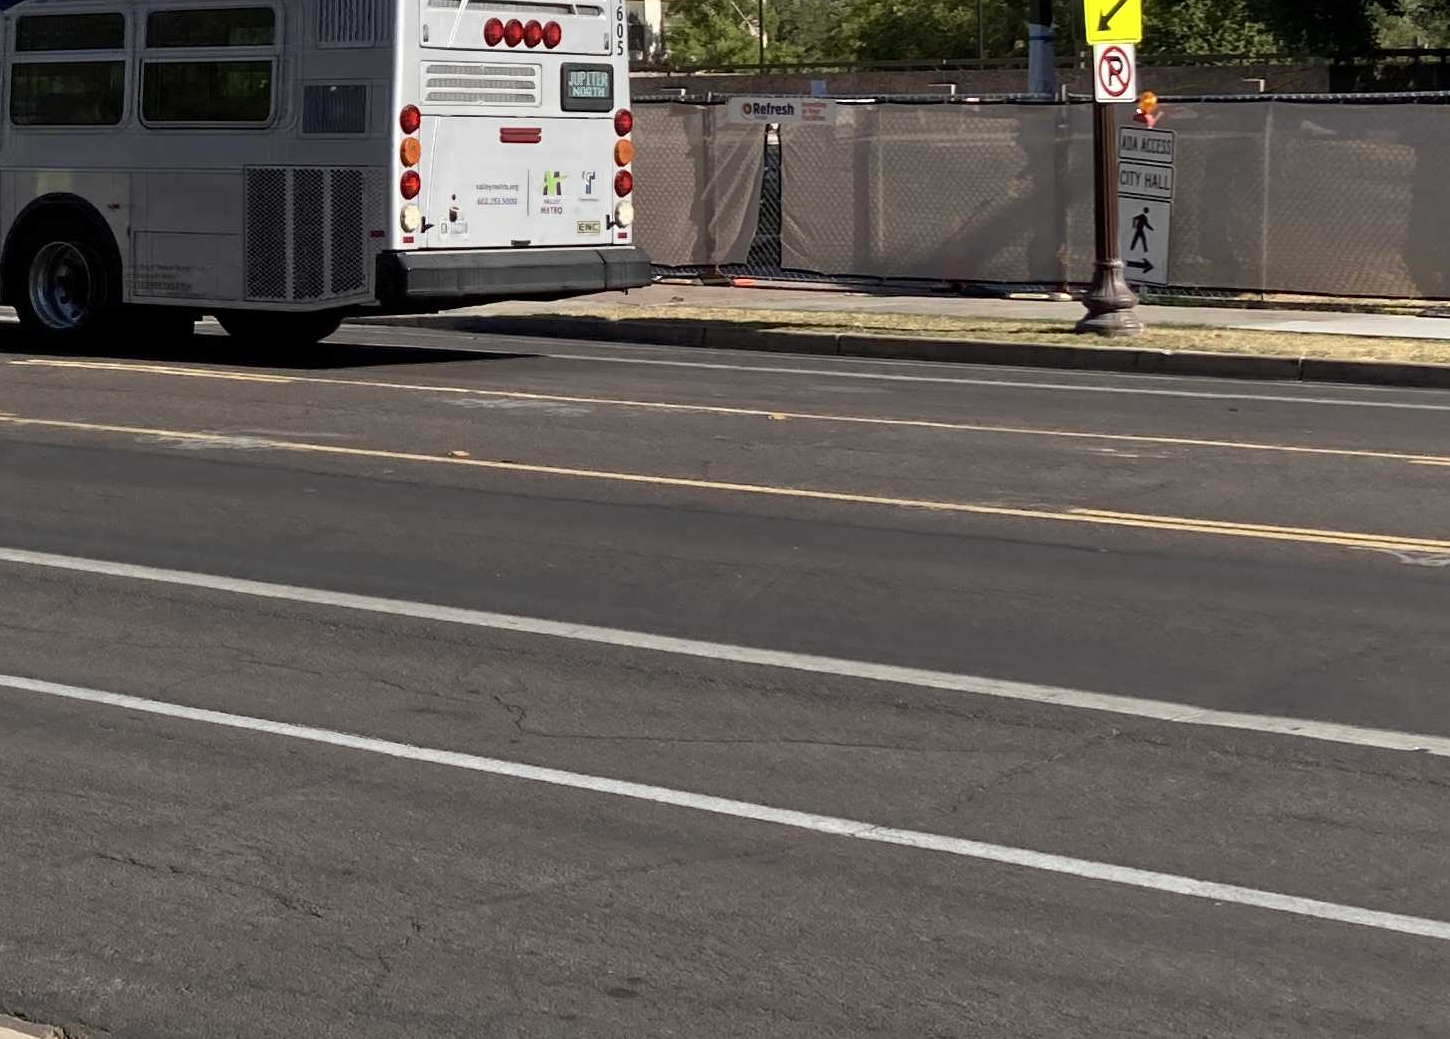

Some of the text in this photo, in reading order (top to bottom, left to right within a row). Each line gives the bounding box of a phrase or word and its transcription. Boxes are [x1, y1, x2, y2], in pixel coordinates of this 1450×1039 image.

[568, 71, 608, 86] JUPITER
[572, 86, 606, 98] NORTH
[753, 102, 794, 116] Refresh
[1122, 136, 1172, 154] ADA ACCESS
[1120, 170, 1171, 190] CITY HALL
[540, 206, 563, 215] METRO
[578, 223, 600, 233] ENC
